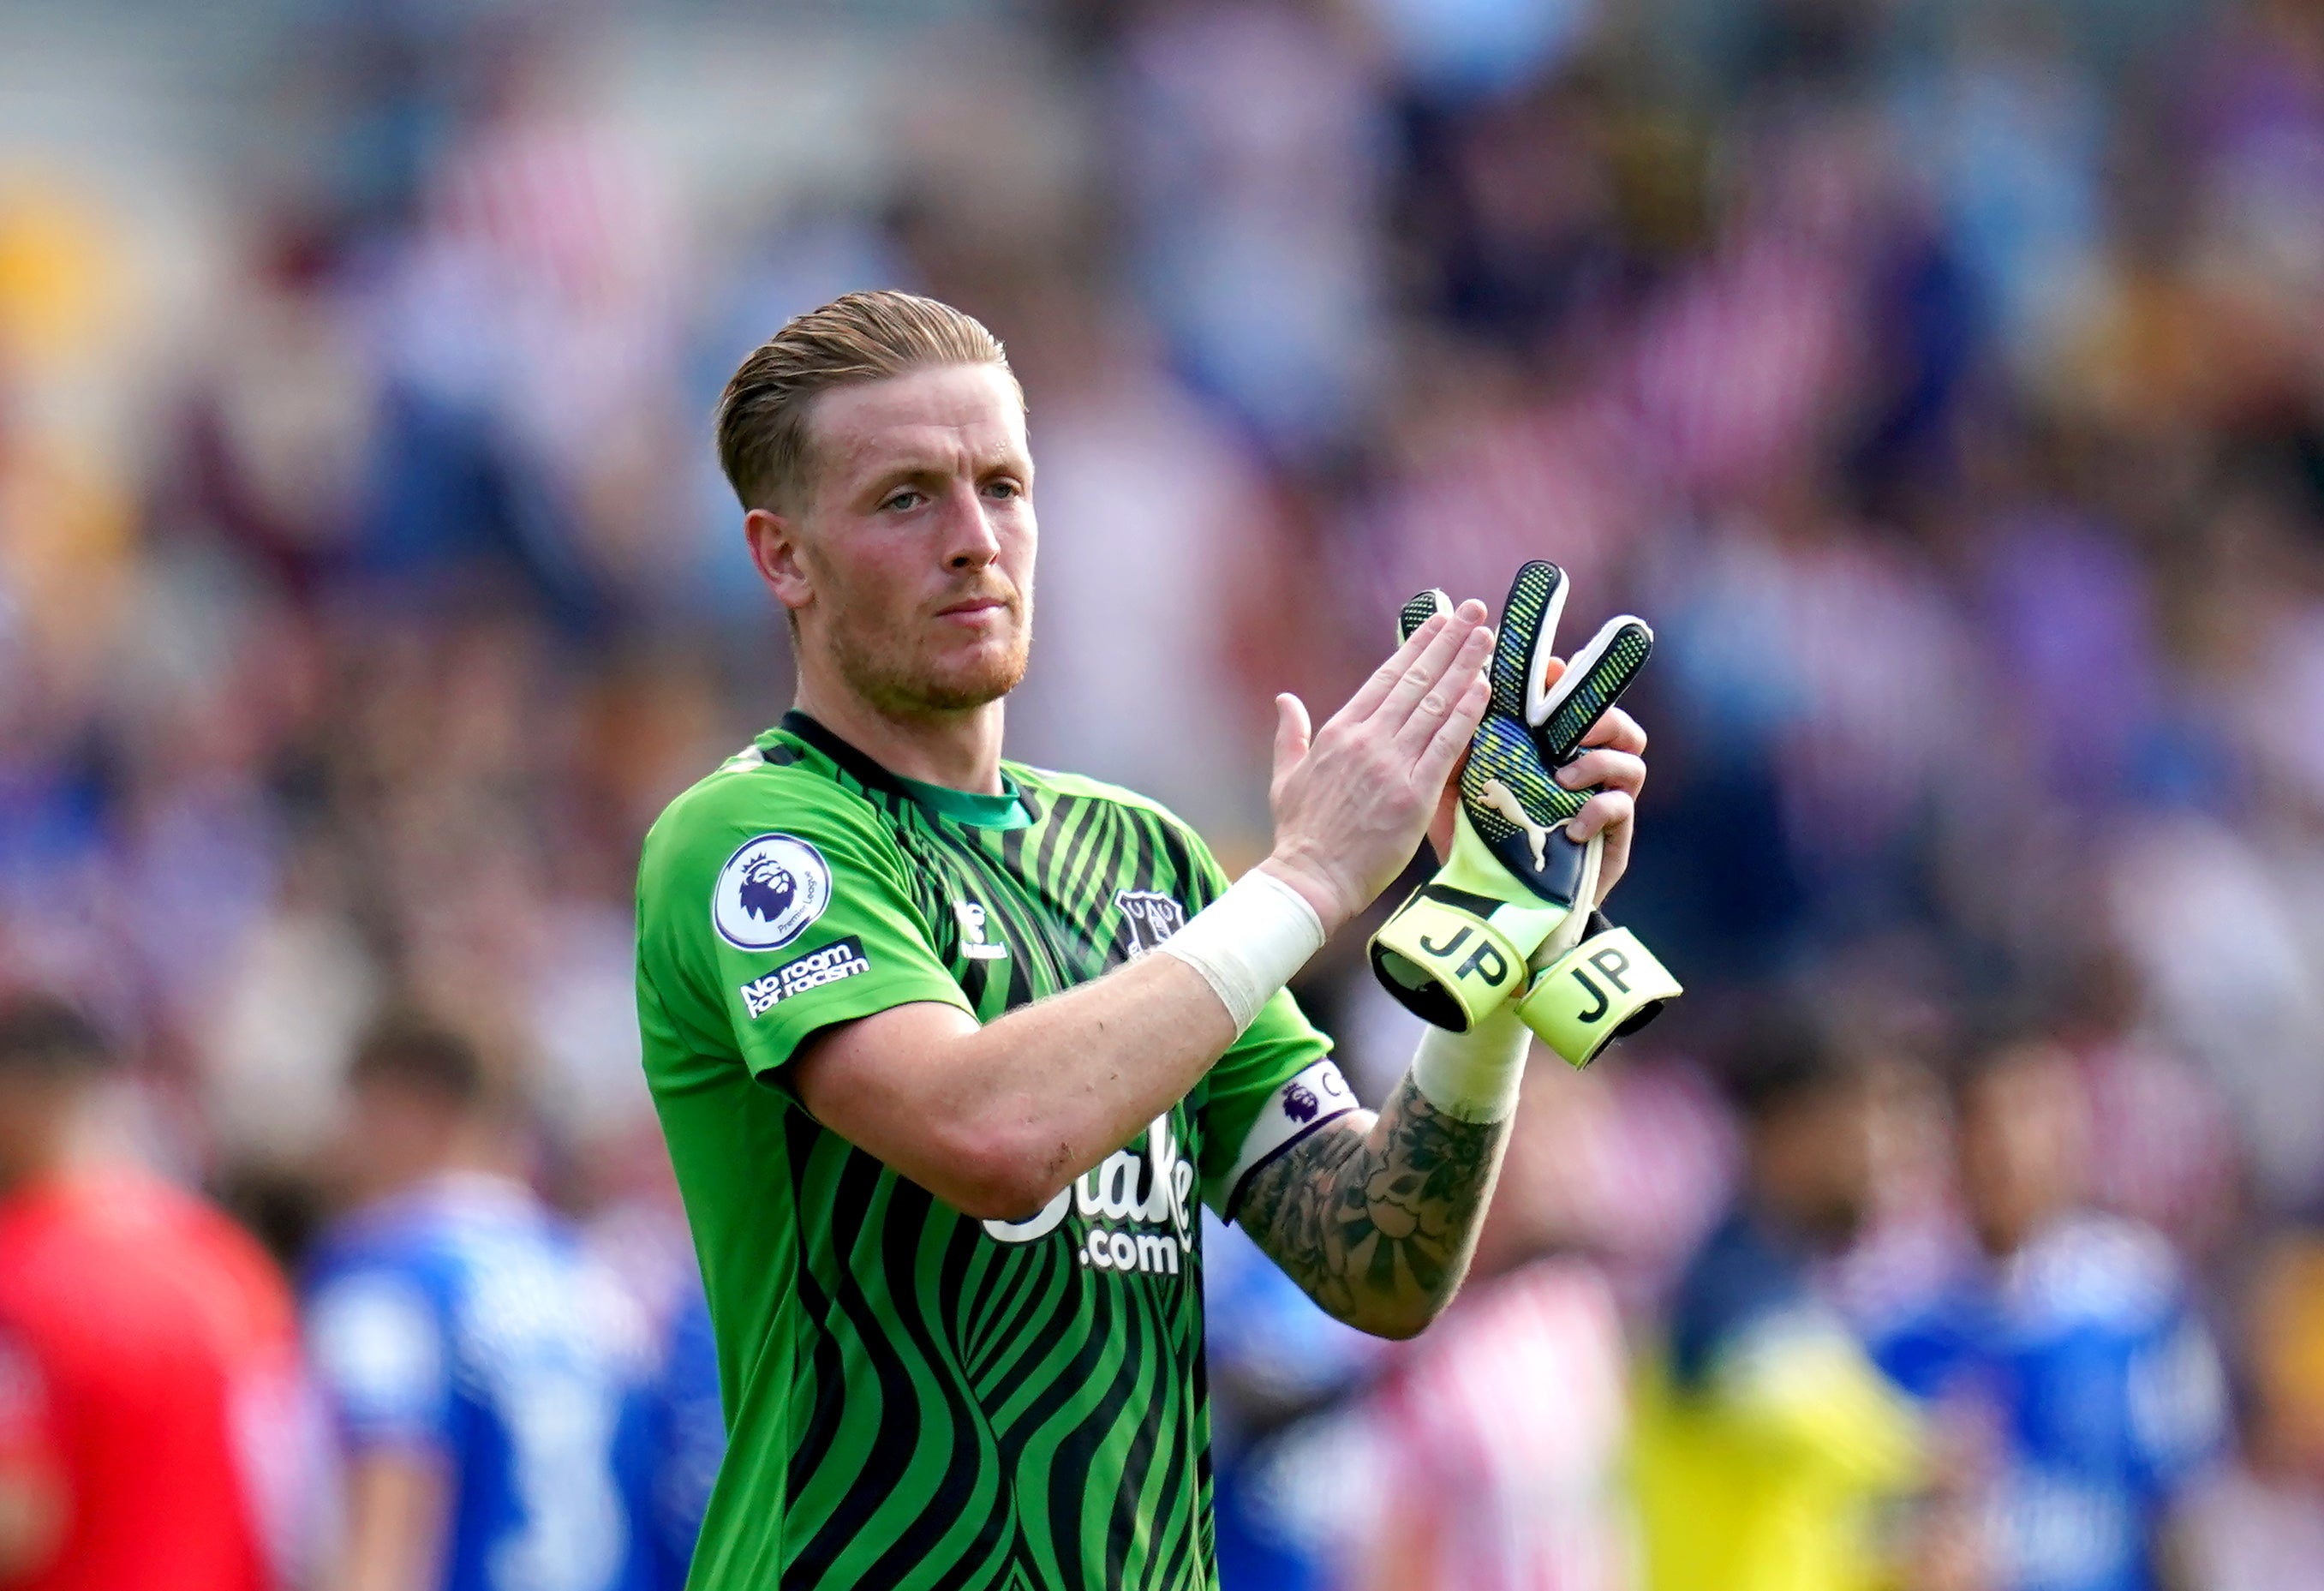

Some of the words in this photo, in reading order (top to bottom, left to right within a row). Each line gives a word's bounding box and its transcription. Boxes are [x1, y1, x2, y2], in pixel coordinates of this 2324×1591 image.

[777, 905, 808, 934] Premier
[803, 870, 817, 904] League
[740, 973, 780, 1000] No
[780, 944, 852, 984] room
[1419, 926, 1508, 986] JP
[1570, 948, 1631, 1023] JP
[746, 989, 783, 1020] for
[785, 958, 870, 998] racism
[982, 1112, 1193, 1253] ake
[1079, 1229, 1179, 1274] .com
